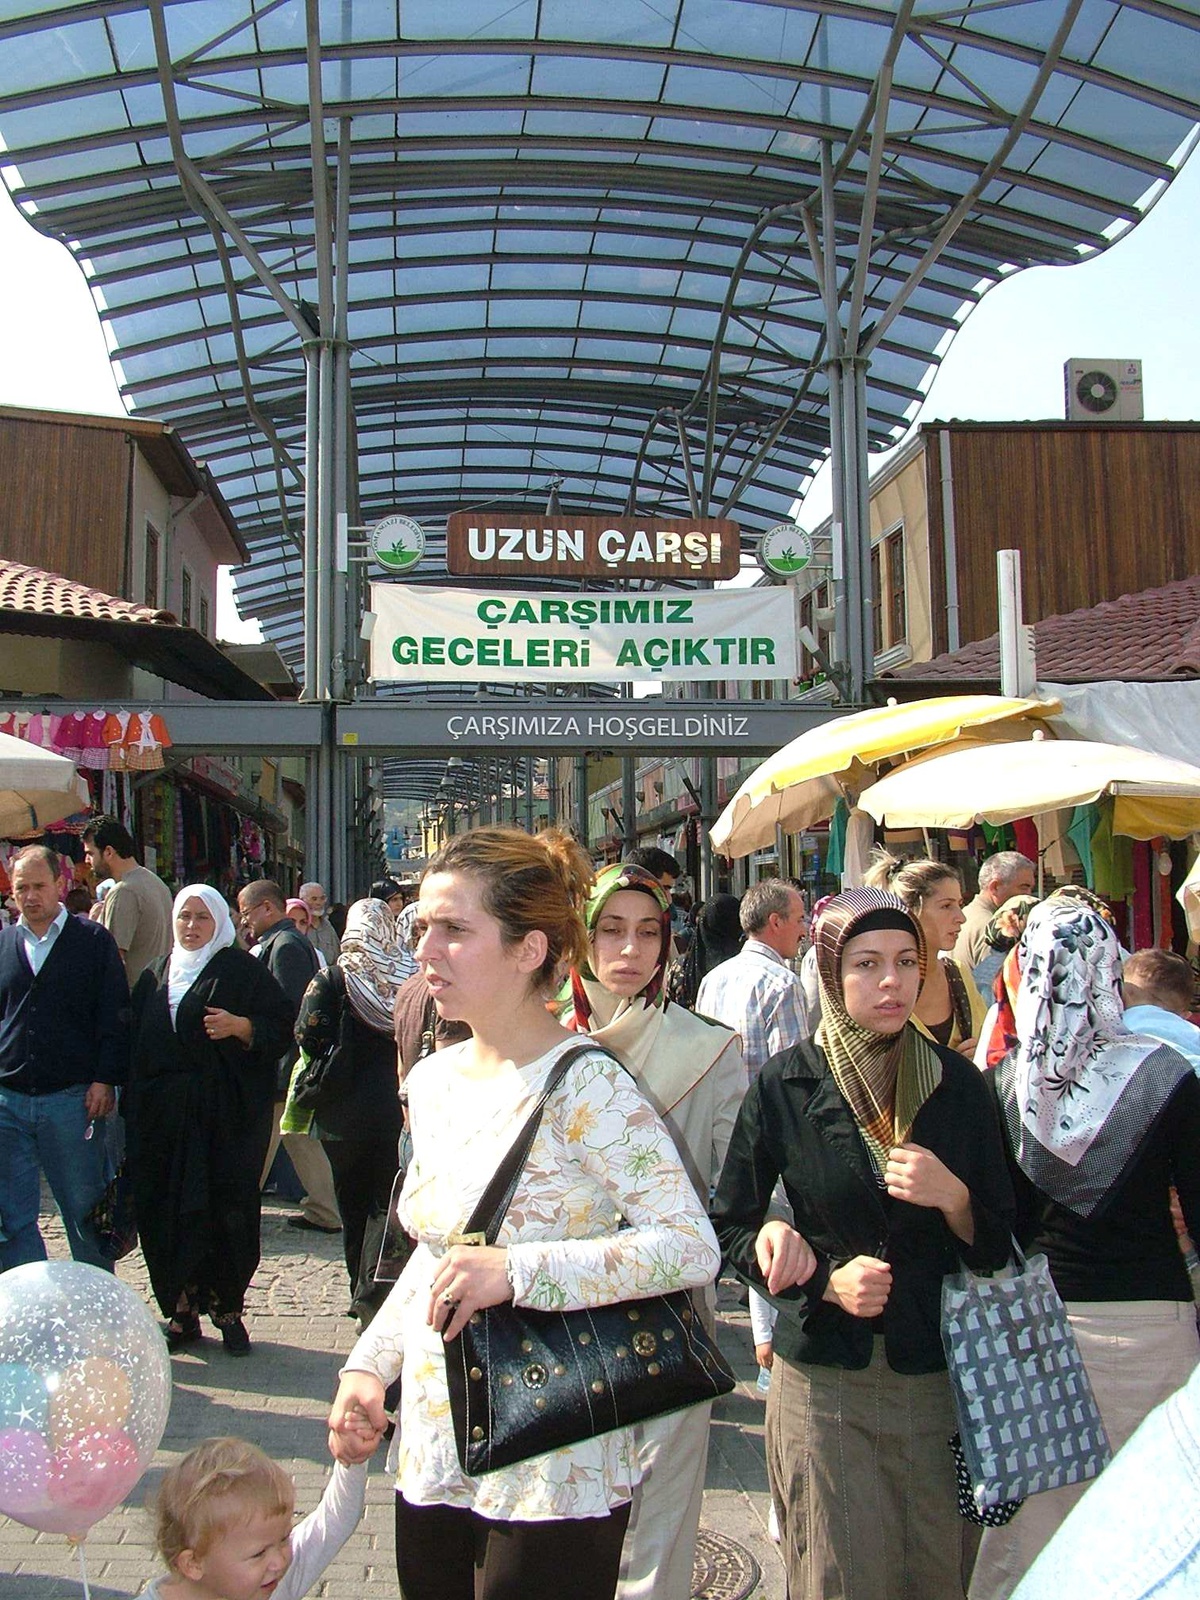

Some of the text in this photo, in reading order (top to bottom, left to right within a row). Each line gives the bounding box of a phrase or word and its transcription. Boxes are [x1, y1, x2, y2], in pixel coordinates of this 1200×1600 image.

[468, 528, 722, 569] UZUN ÇARŞI
[477, 599, 694, 629] ÇARŞIMIZ
[616, 637, 775, 672] AÇIKTIR
[447, 713, 749, 740] ÇARŞIMIZA HOŞGELDİNİZ
